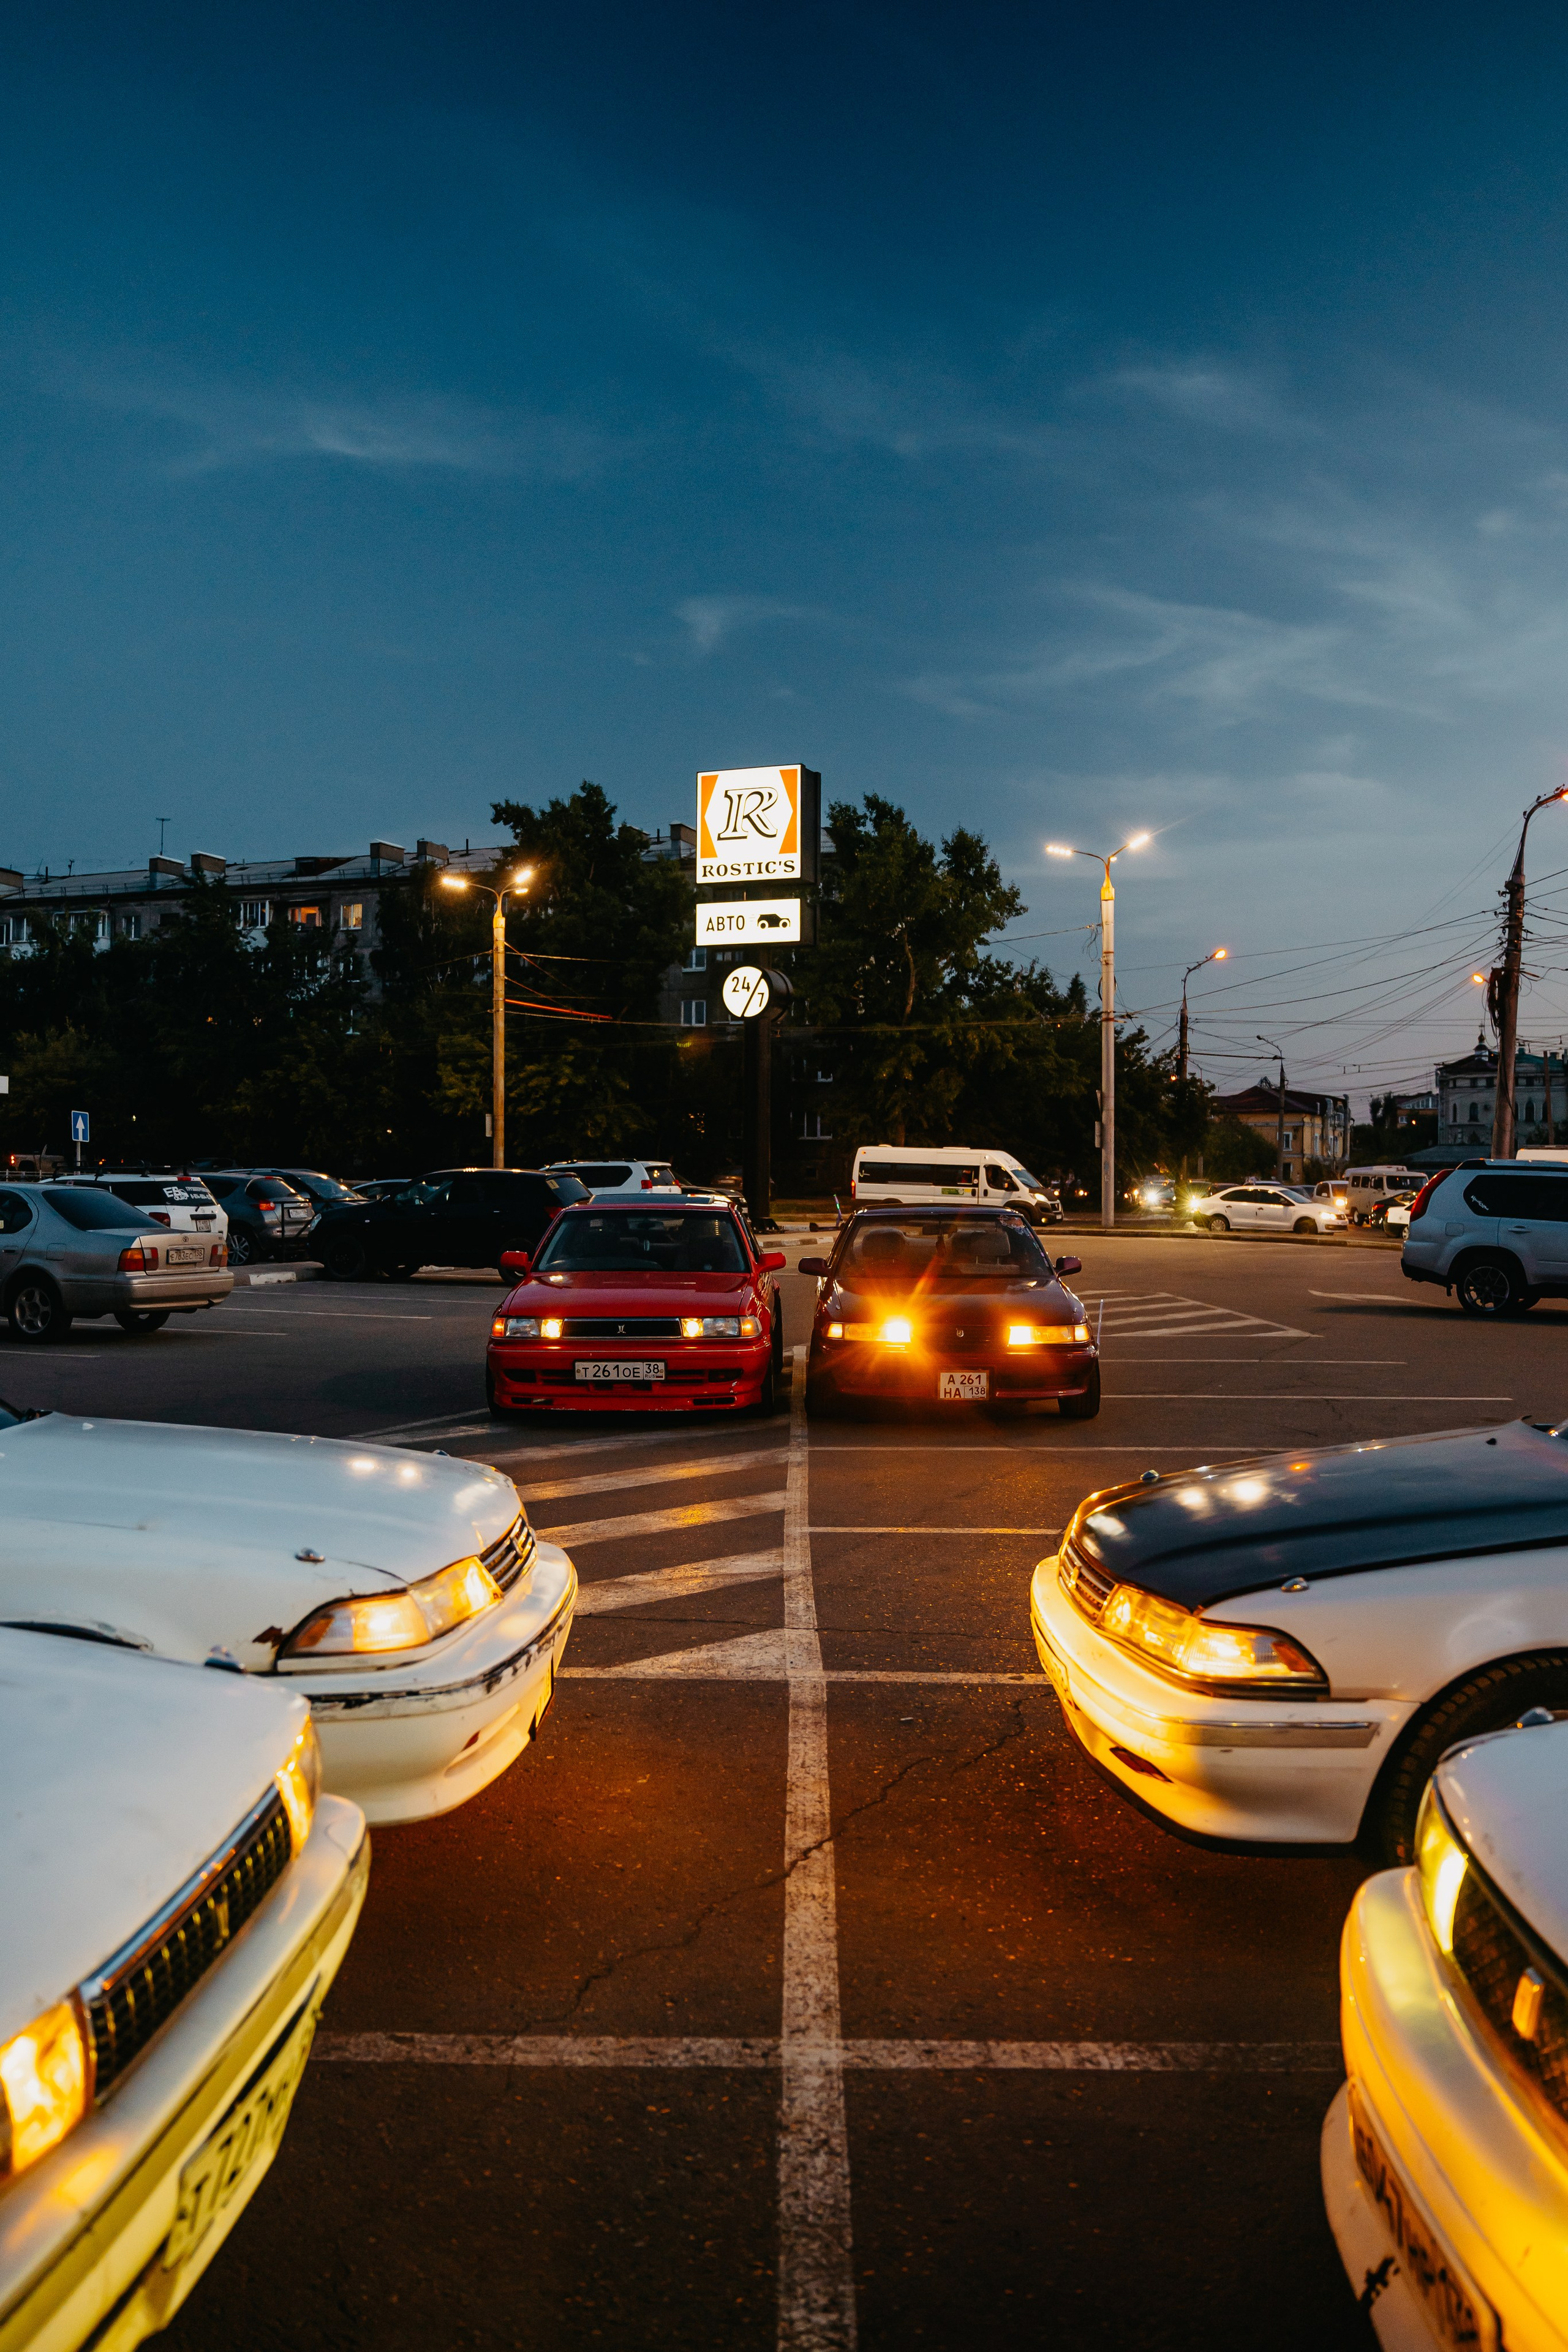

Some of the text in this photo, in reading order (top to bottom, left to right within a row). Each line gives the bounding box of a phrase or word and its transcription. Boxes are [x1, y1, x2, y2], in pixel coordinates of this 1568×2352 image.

[702, 859, 796, 878] ROSTIC'S
[706, 914, 745, 932] АВТО
[645, 1363, 660, 1374] 38
[960, 1374, 981, 1385] 261
[944, 1387, 986, 1398] НА 138
